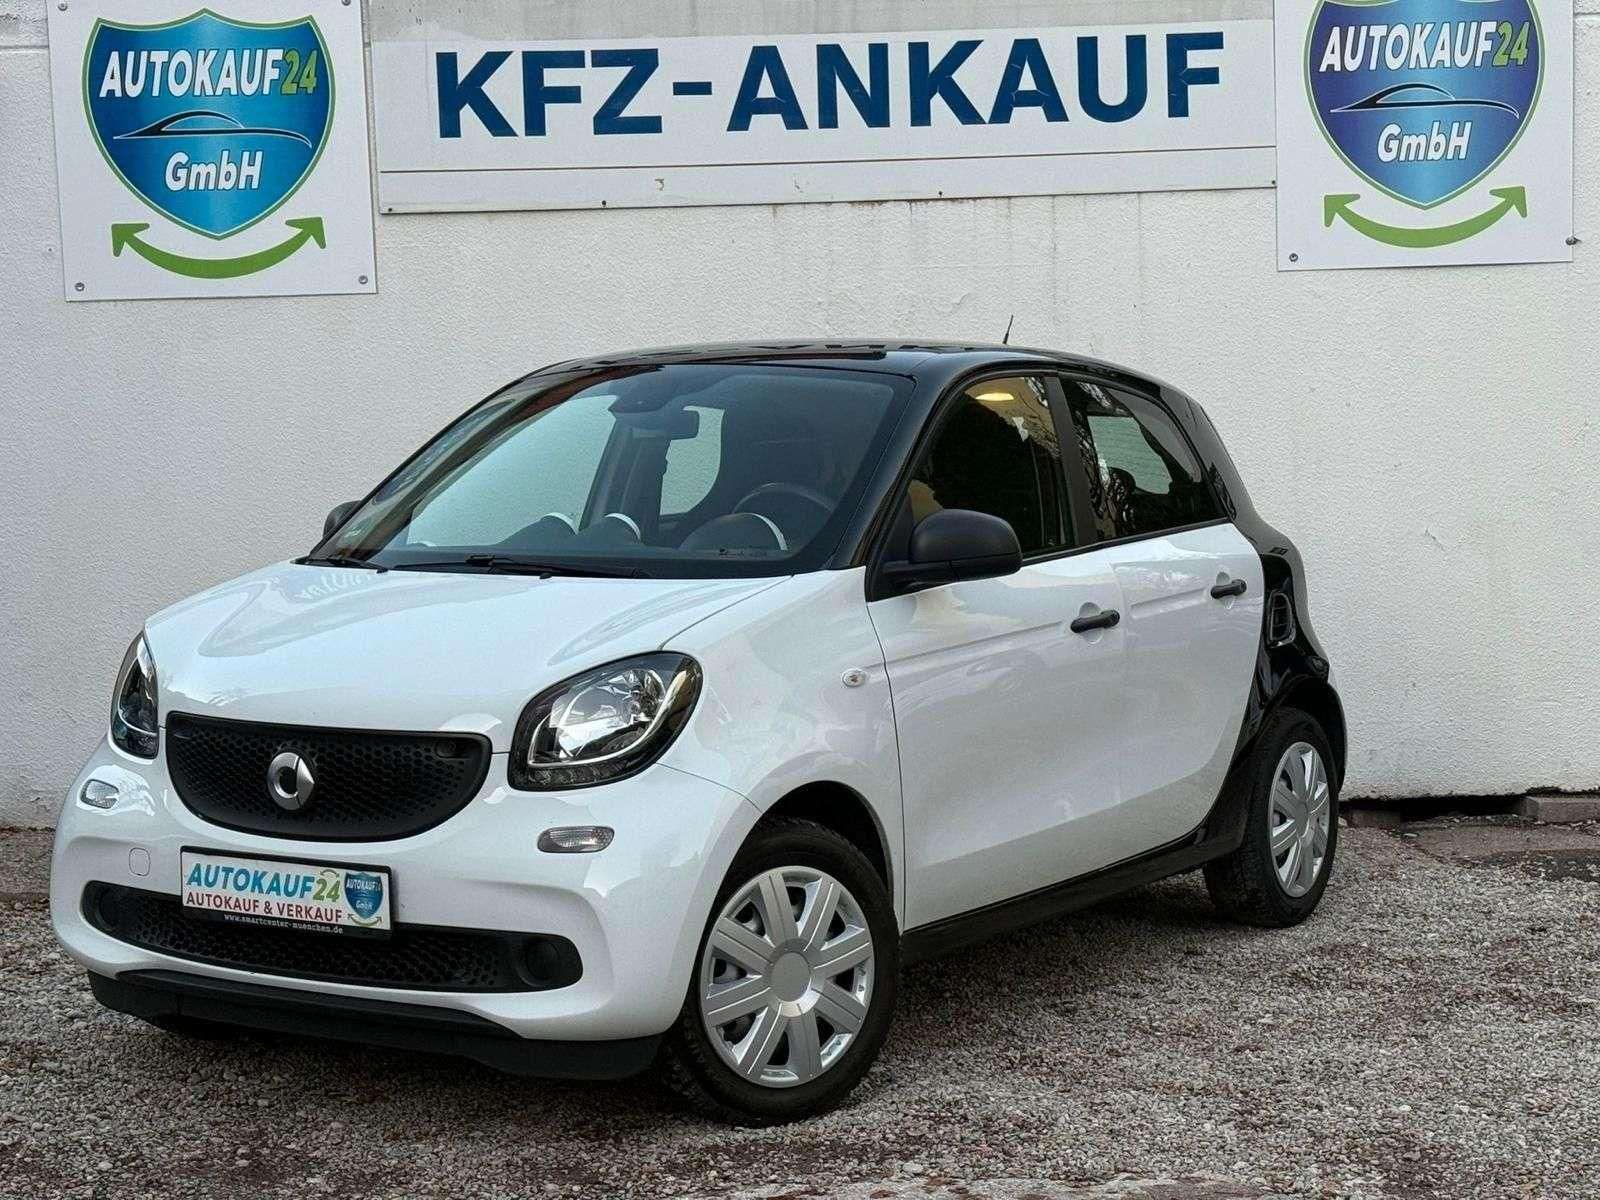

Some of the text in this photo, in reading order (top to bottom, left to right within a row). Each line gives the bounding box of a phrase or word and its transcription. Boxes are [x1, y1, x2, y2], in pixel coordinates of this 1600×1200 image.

[1318, 20, 1531, 73] AUTOKAUF24
[98, 48, 319, 98] AUTOKAUF24
[1376, 120, 1473, 163] GmbH
[164, 149, 264, 192] GmbH
[186, 862, 342, 903] AUTOKAUF24
[186, 891, 343, 923] AUTOKAUF & VERKAUF
[223, 913, 344, 934] www.smartcenter-muenchen.de
